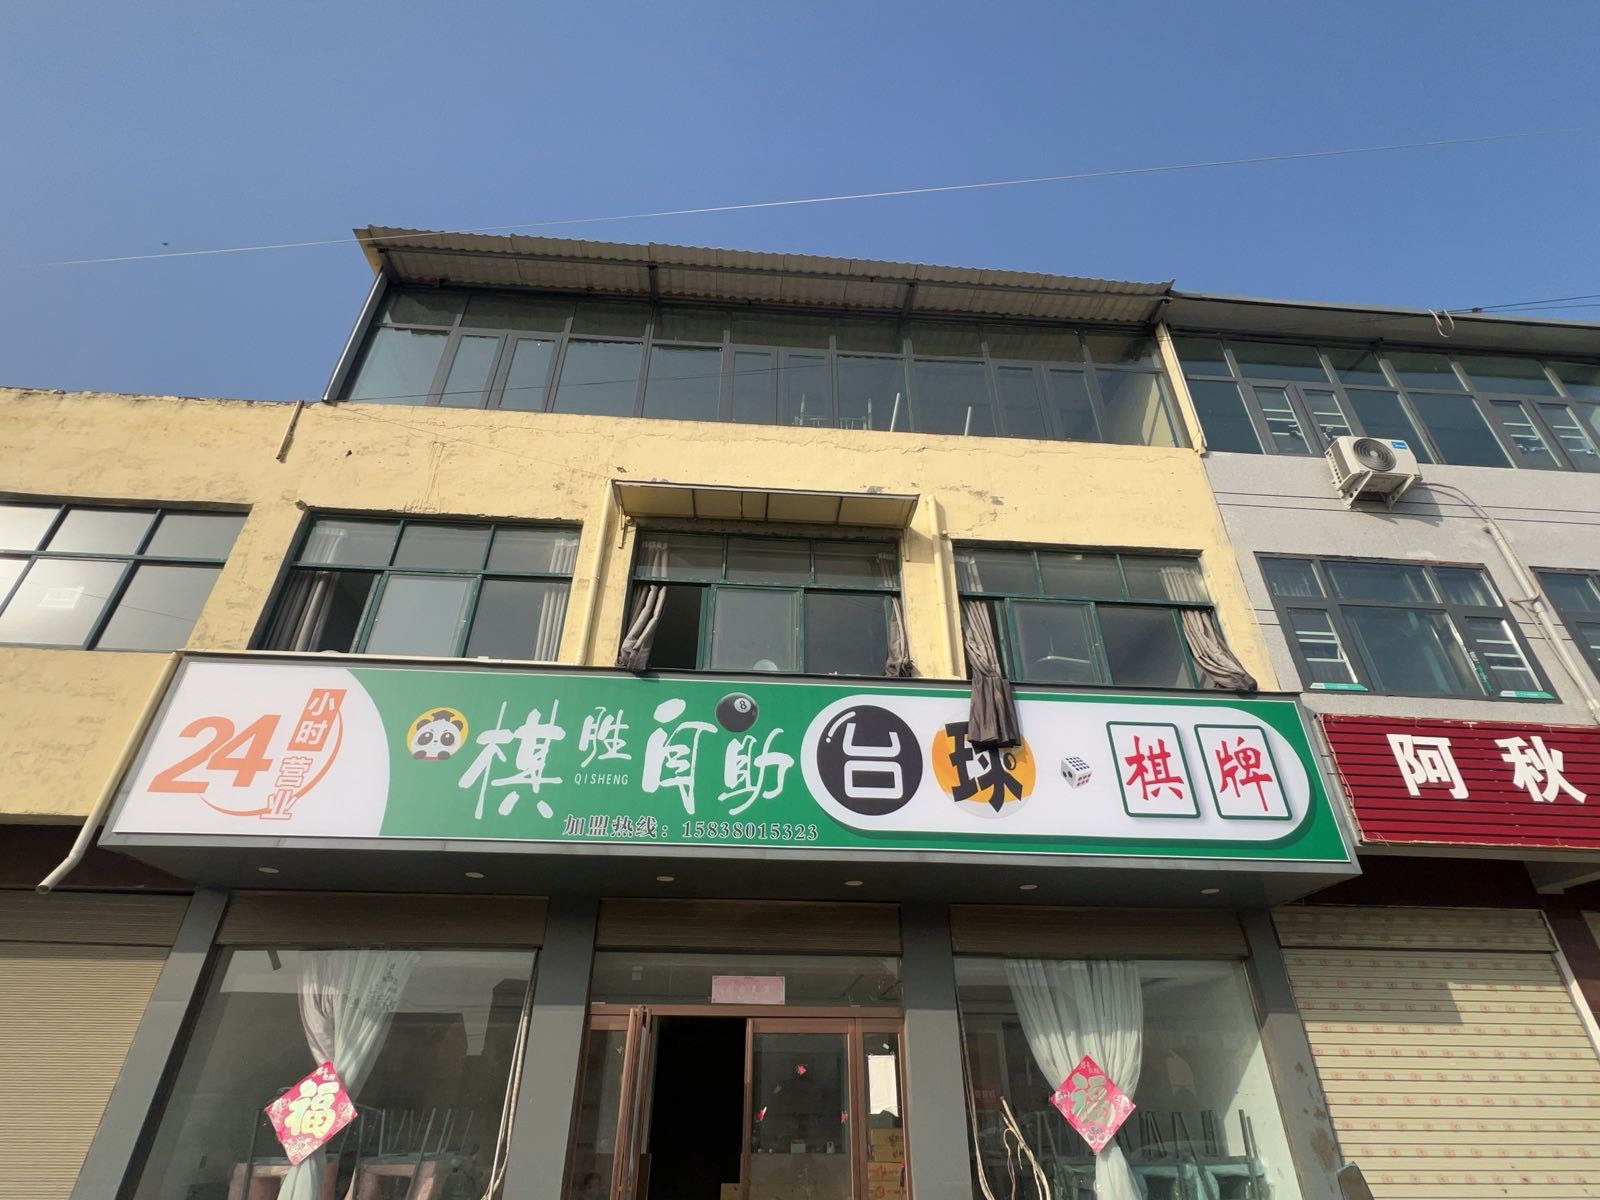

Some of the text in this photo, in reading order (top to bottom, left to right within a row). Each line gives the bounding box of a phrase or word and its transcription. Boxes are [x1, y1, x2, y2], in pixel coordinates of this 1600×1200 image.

[147, 714, 282, 793] 24
[1124, 735, 1273, 812] 棋牌
[1386, 733, 1587, 804] 阿秋
[285, 1080, 339, 1137] 福
